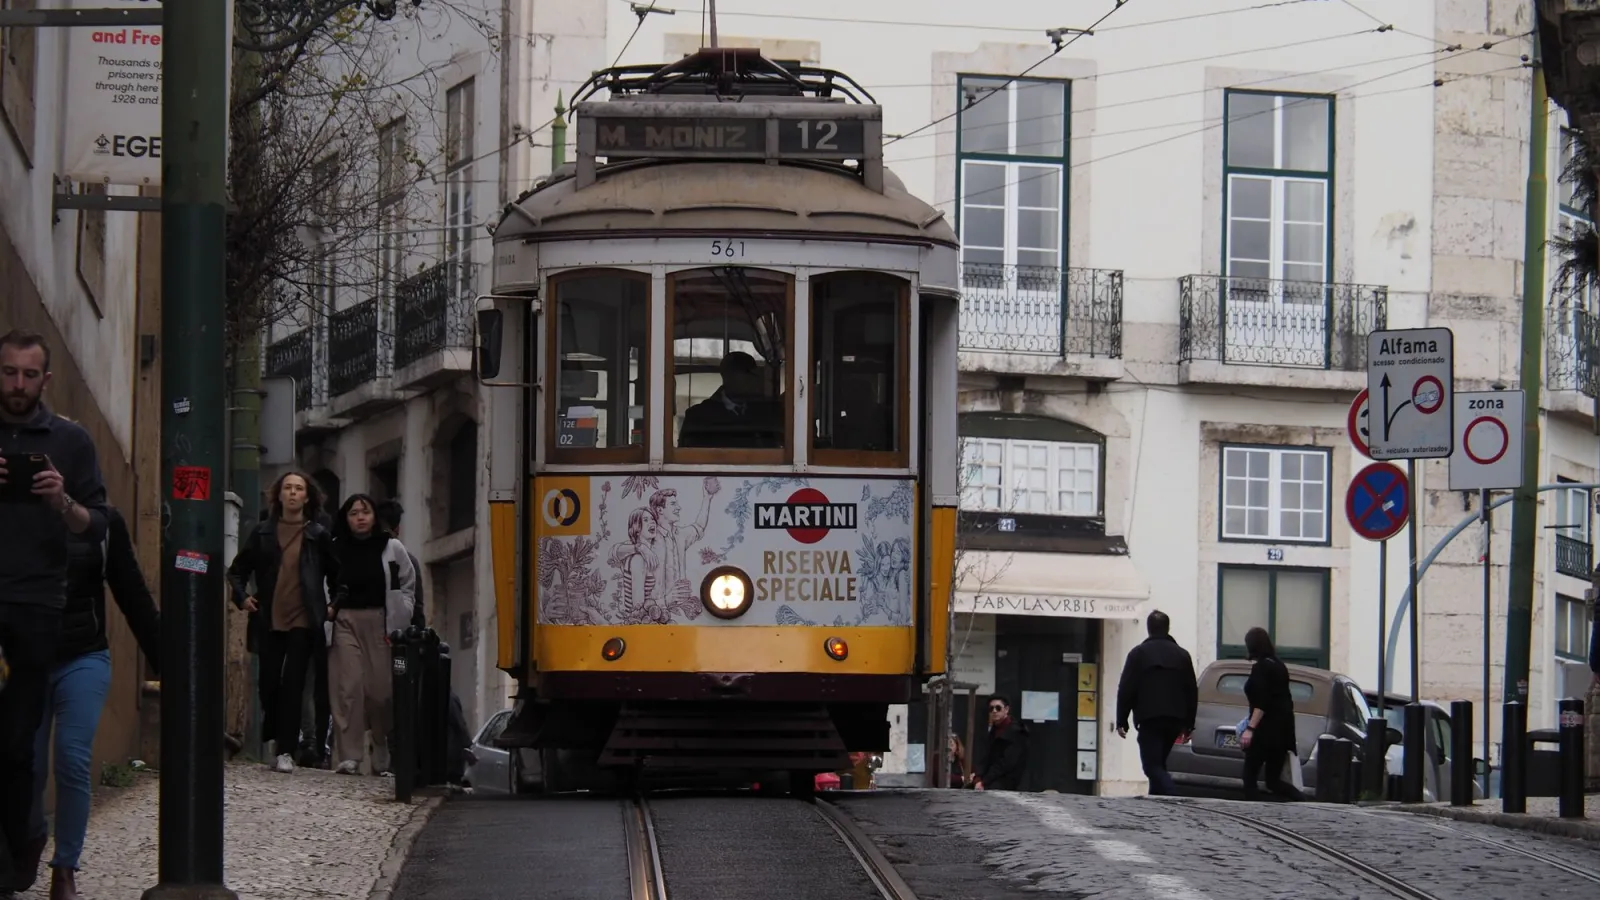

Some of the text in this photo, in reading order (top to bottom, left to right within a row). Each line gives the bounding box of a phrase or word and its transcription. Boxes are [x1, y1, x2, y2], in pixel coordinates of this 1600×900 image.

[92, 29, 126, 44] and
[98, 56, 150, 68] Thousands
[108, 69, 154, 80] prisoners
[96, 81, 159, 93] through here
[112, 94, 159, 104] 1928 and
[645, 126, 746, 148] MONIZ
[797, 120, 838, 149] 12
[711, 240, 746, 257] 561
[1379, 338, 1437, 355] Alfama
[1398, 356, 1445, 365] condicionado
[1468, 399, 1504, 409] zona
[560, 434, 574, 444] 02
[758, 505, 854, 526] MARTINI
[1001, 519, 1013, 530] 27
[1269, 549, 1282, 560] 29
[763, 550, 851, 574] RISERVA
[756, 577, 857, 602] SPECIALE
